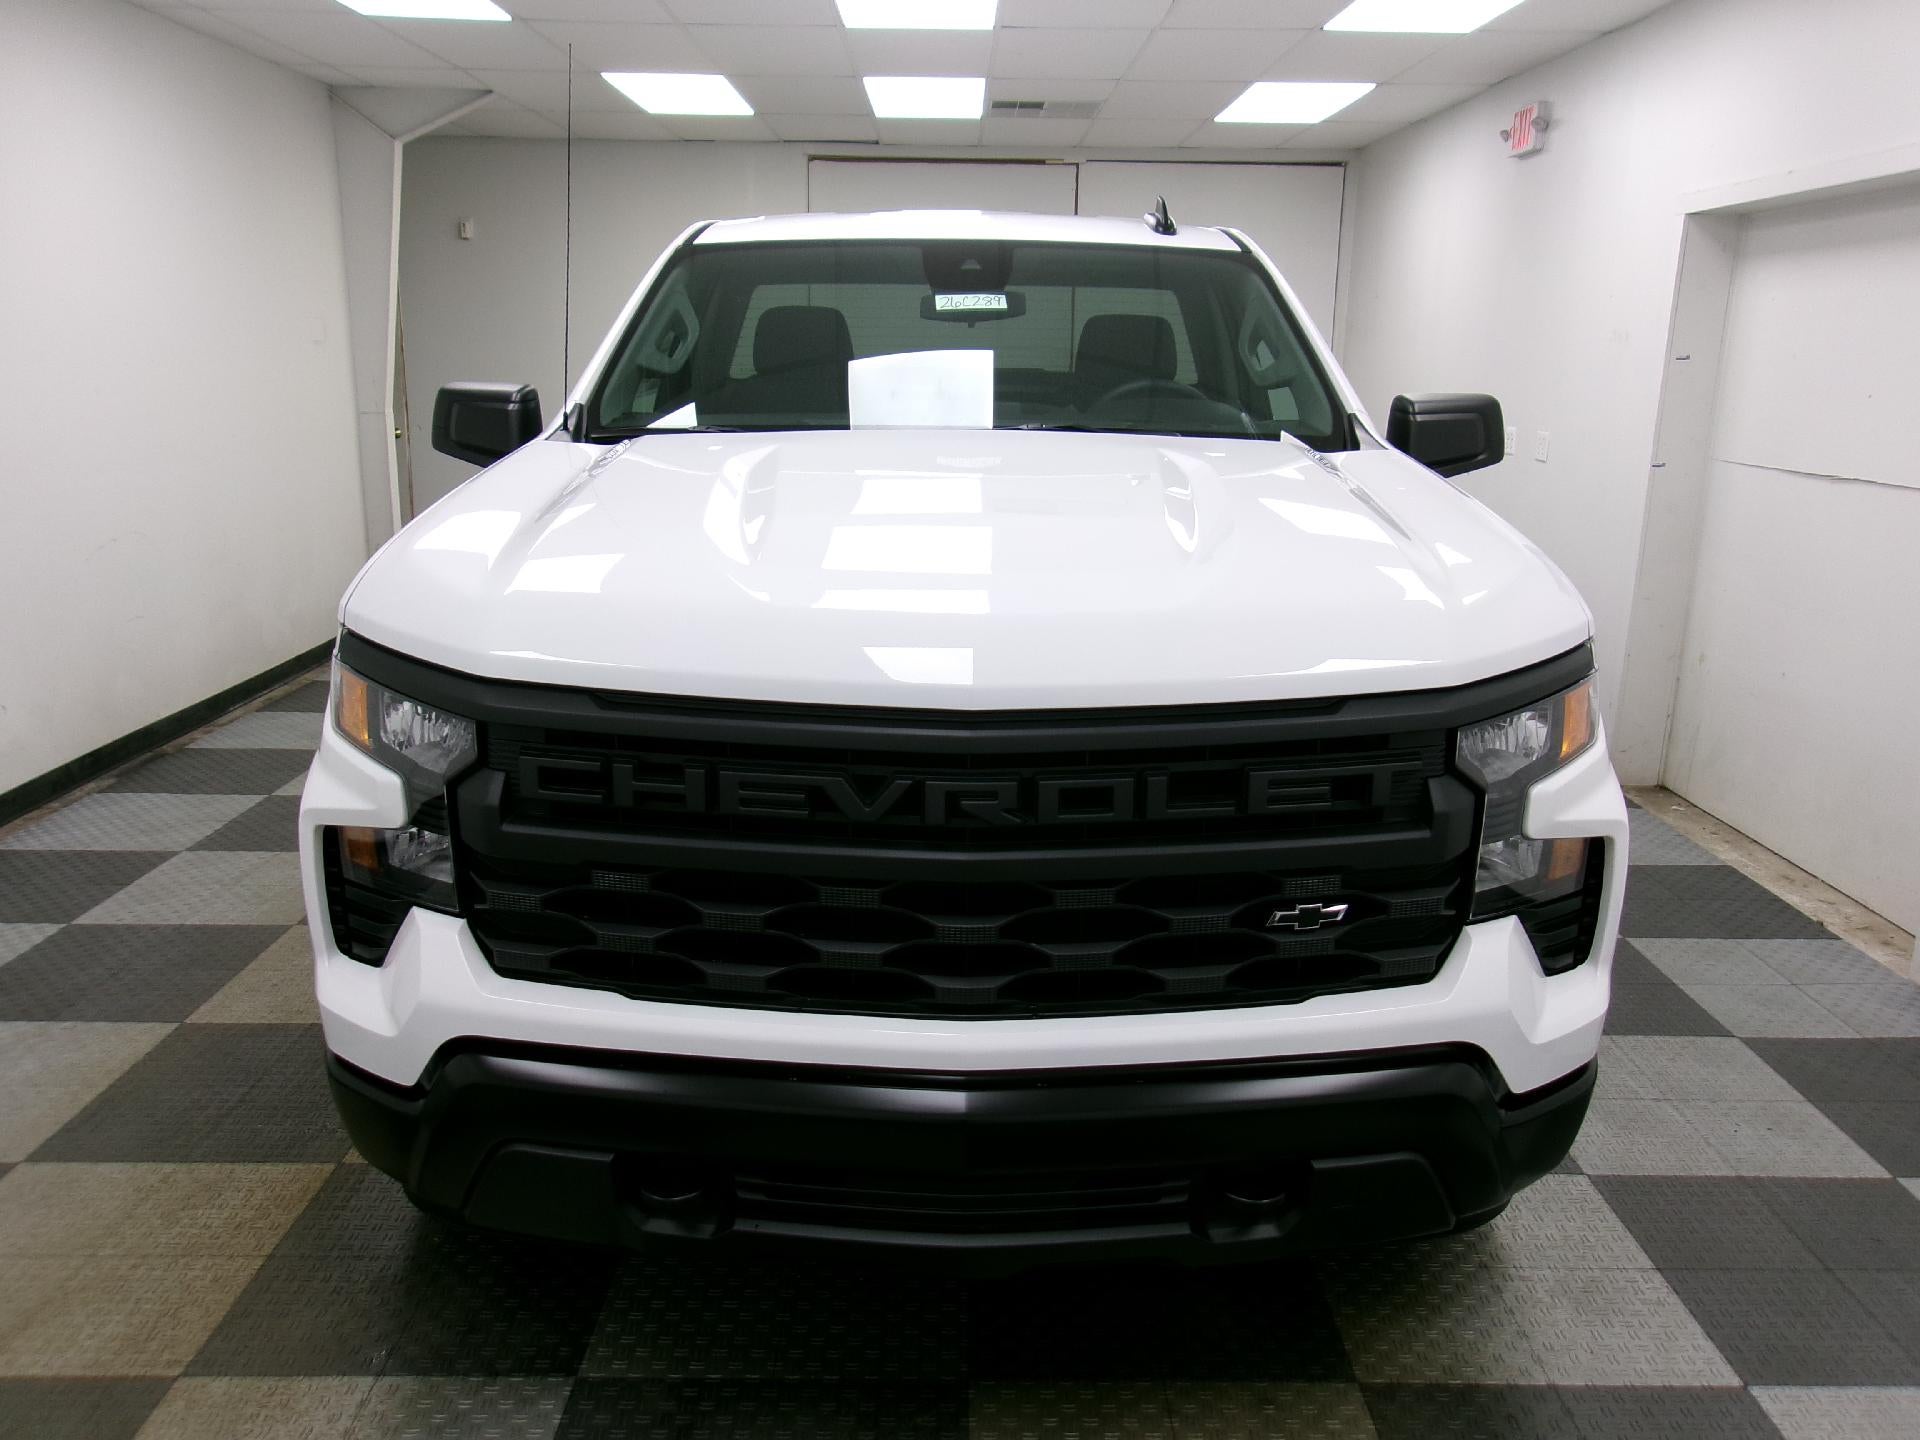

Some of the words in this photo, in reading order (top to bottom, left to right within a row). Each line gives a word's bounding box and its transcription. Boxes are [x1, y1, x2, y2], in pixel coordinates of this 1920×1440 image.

[1511, 105, 1536, 151] EXIT
[940, 295, 1002, 308] 26C289
[518, 753, 1424, 826] CHEVROLET
